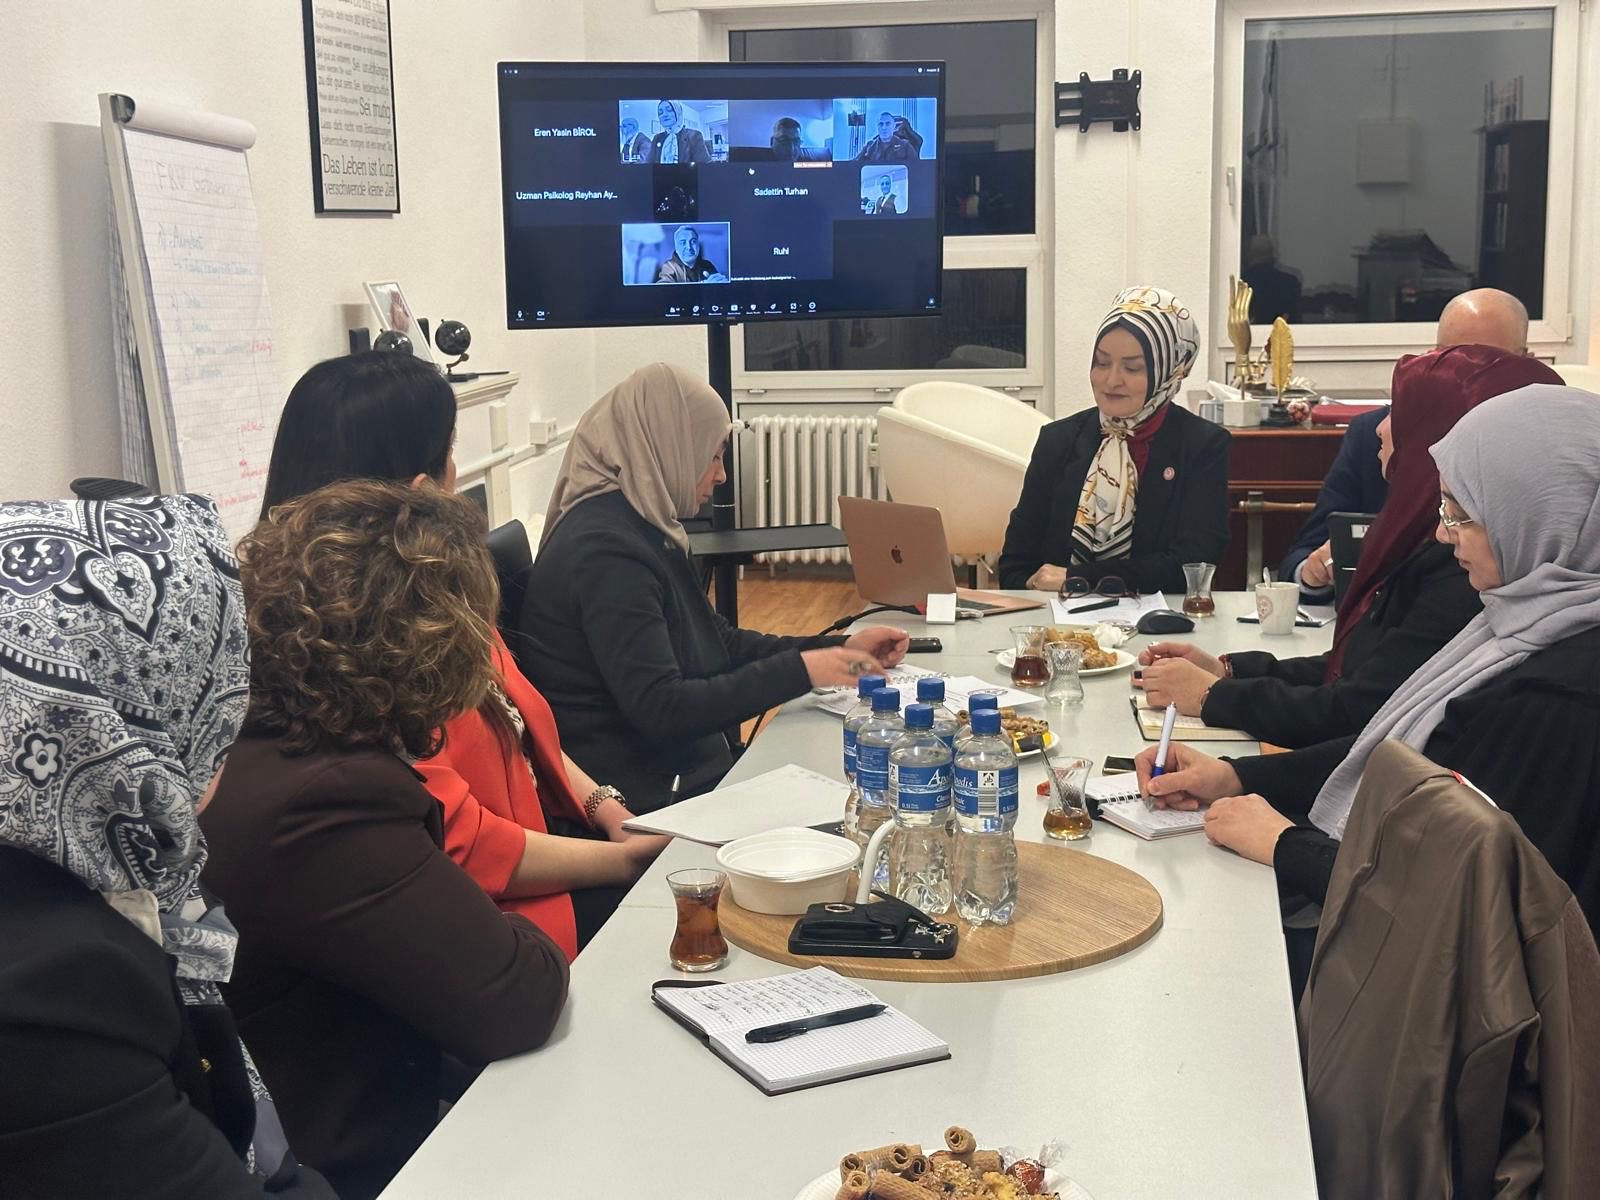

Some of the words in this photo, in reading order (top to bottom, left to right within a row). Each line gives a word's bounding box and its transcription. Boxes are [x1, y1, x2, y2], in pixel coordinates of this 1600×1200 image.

[360, 96, 371, 117] Sei
[534, 128, 551, 137] Eren
[552, 128, 572, 137] Yasin
[322, 153, 340, 174] Das
[342, 154, 368, 176] Leben
[368, 156, 377, 177] ist
[516, 191, 543, 200] Uzman
[543, 191, 575, 201] Psikolog
[754, 187, 784, 197] Sadettin
[784, 187, 809, 196] Turhan
[773, 247, 790, 256] Ruhi
